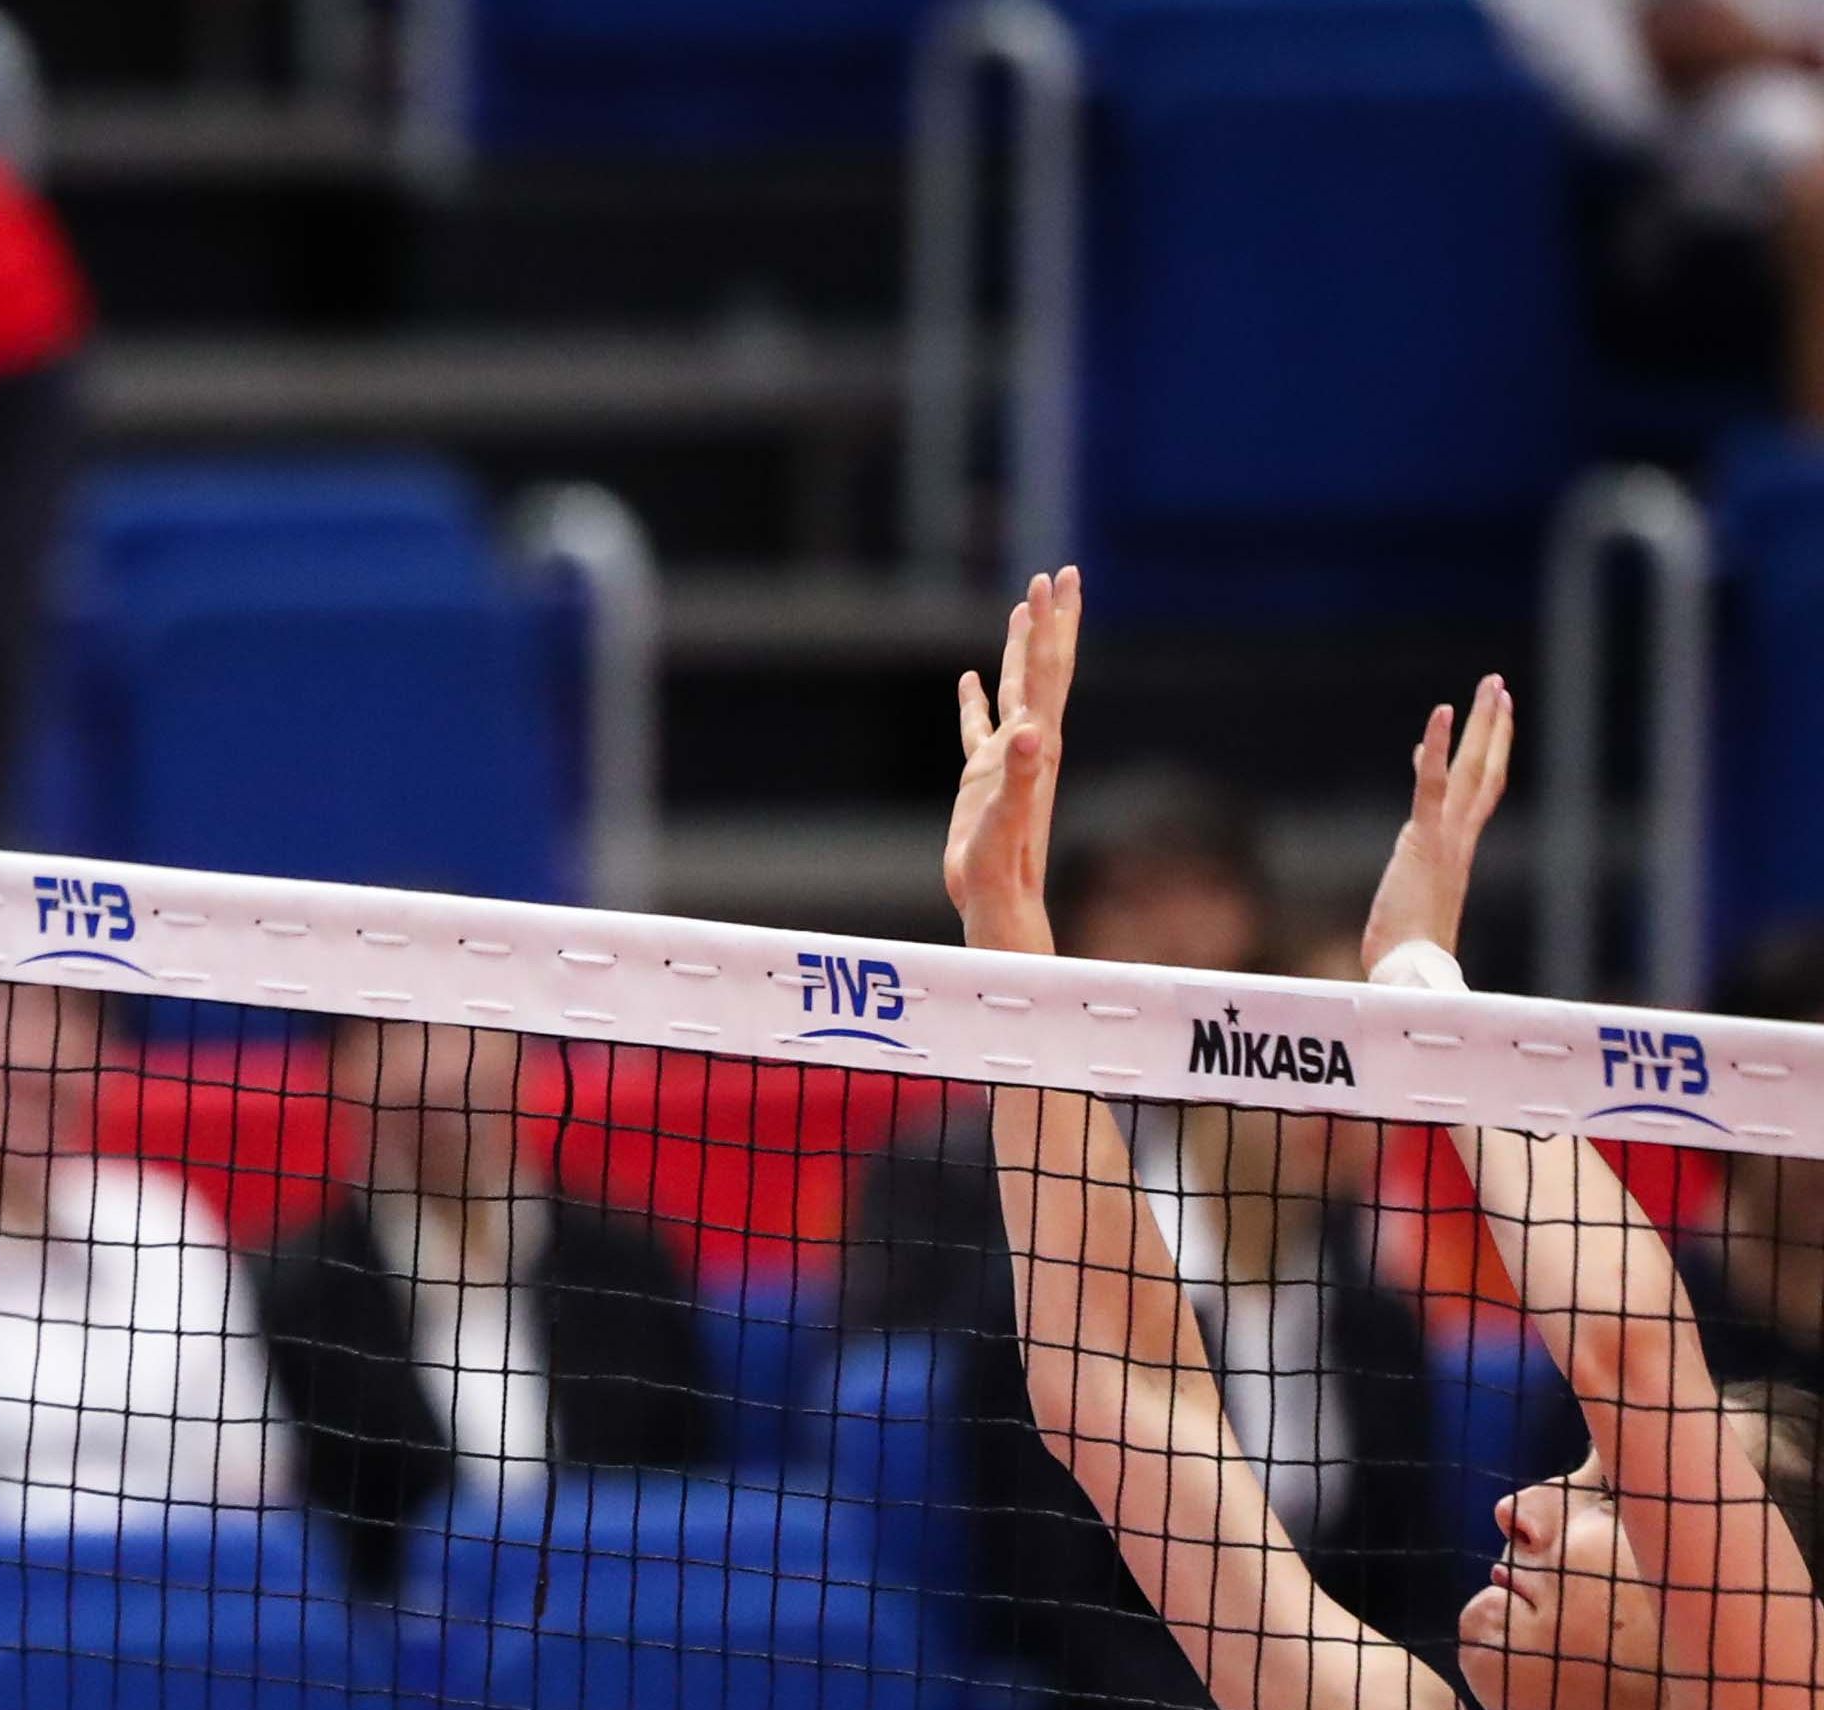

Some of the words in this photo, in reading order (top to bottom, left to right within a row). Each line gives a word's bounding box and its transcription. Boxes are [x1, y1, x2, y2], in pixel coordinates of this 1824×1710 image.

[33, 876, 136, 942] FIVB
[797, 952, 905, 1021] FIVB
[1598, 1026, 1710, 1095] FIVB
